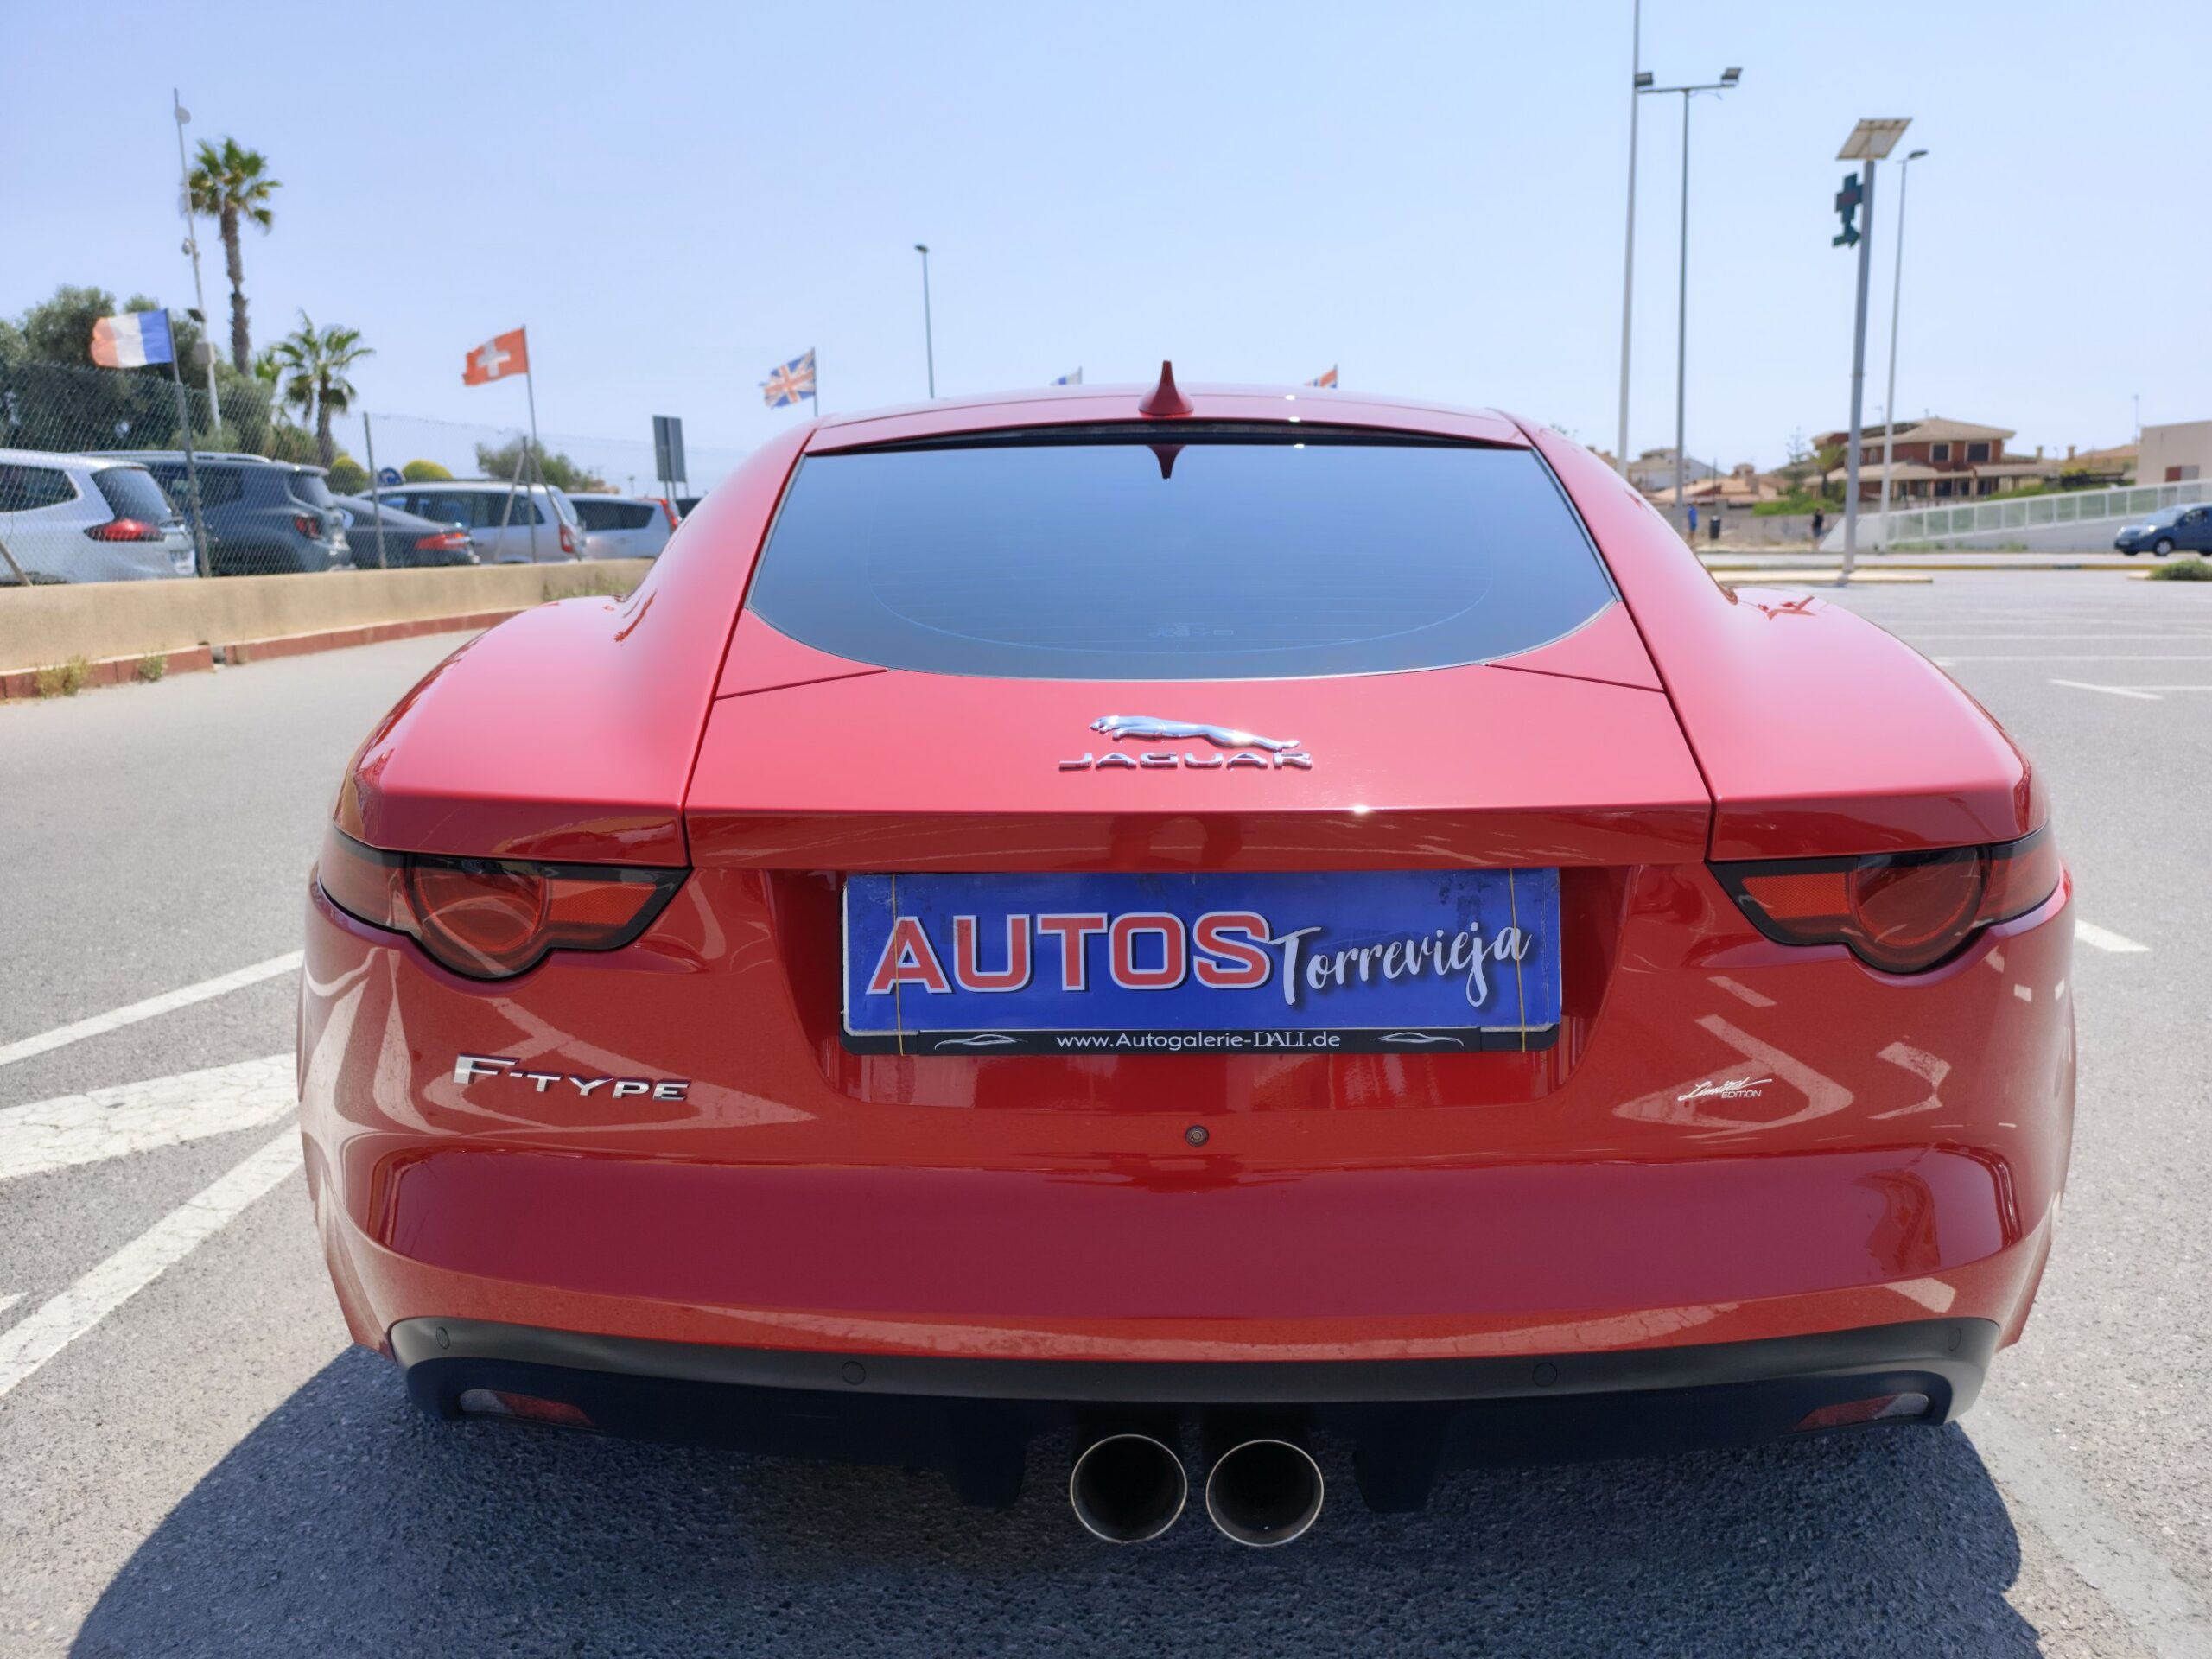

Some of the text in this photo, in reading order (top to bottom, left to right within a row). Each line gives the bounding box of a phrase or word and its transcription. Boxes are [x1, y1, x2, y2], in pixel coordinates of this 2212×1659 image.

[1058, 752, 1313, 770] JAGUAR
[866, 911, 1532, 1008] AUTOS Torrevieja
[1056, 1030, 1342, 1052] www.Autogalerie-DALI.de
[453, 1052, 691, 1102] F-TYPE
[1720, 1089, 1762, 1099] EDITION
